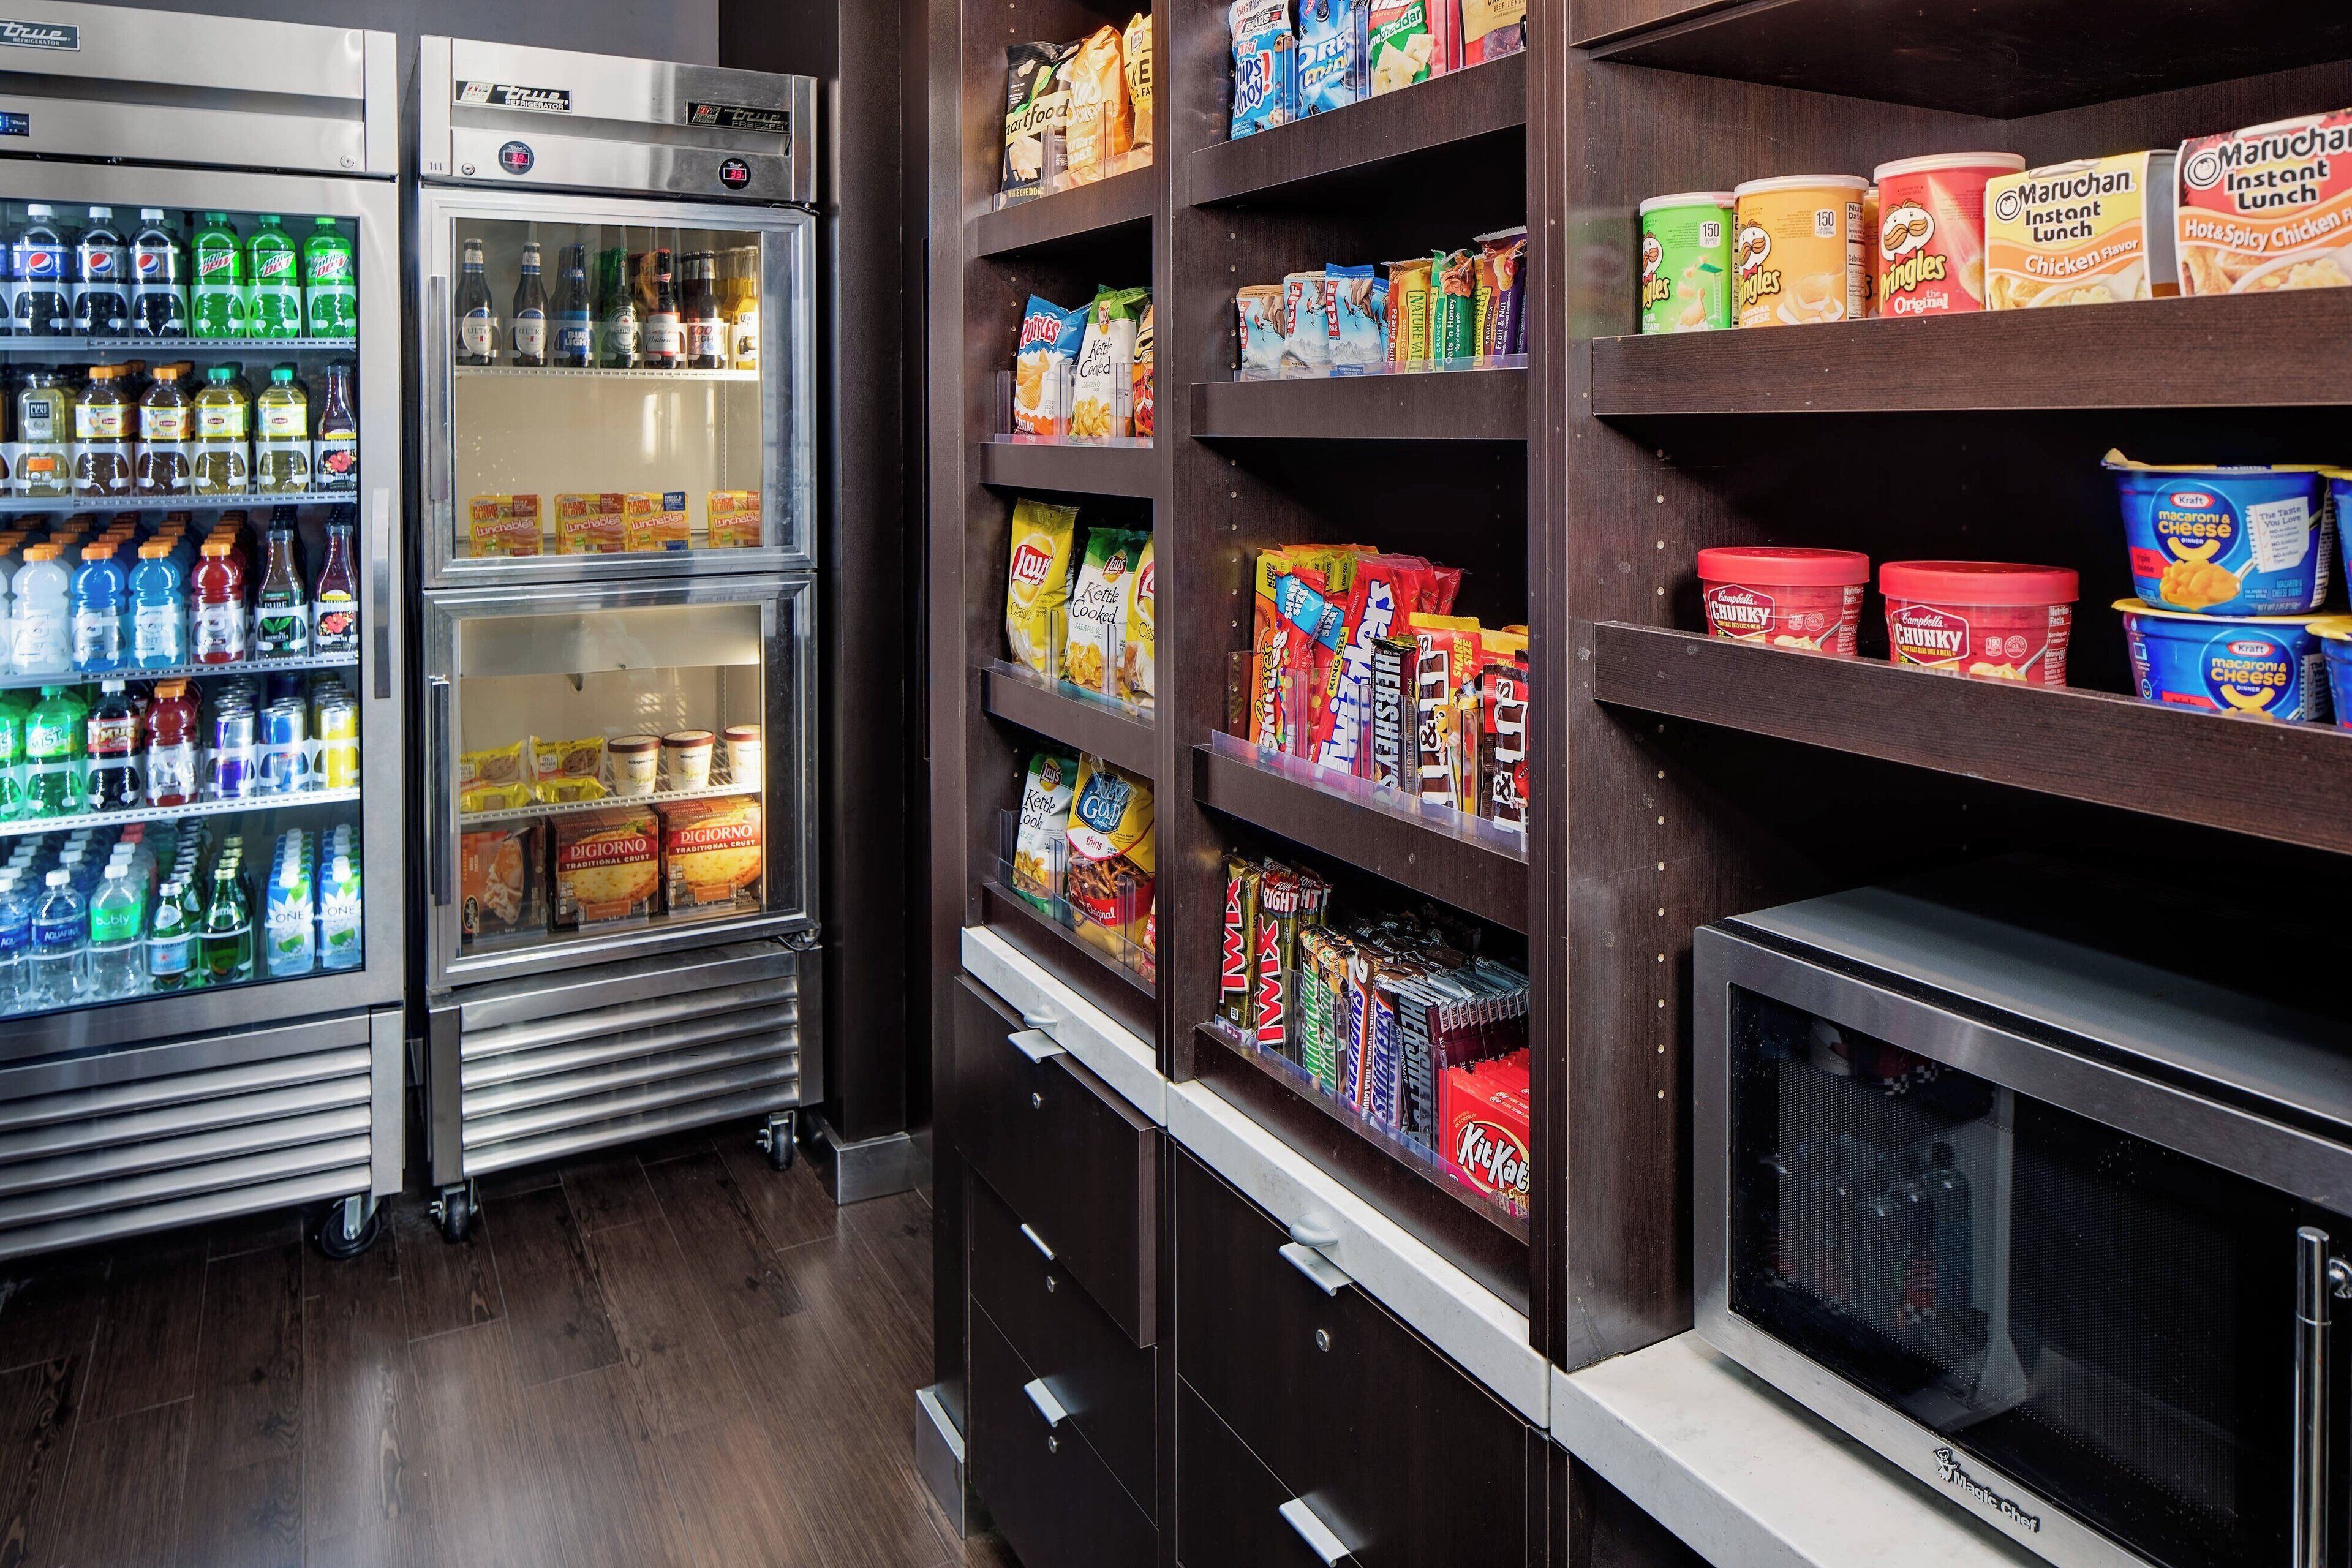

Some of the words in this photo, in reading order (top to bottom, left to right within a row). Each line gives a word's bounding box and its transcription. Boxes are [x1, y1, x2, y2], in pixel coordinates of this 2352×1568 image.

[1237, 2, 1248, 17] BIG
[13, 37, 60, 46] REFRIGERATOR
[497, 86, 565, 104] true
[505, 99, 564, 110] REFRIGERATOR
[724, 108, 784, 125] true
[732, 121, 784, 131] FREEZER
[2228, 159, 2328, 192] Instant
[1008, 189, 1019, 198] WHITE
[2020, 171, 2130, 206] Maruchan
[2238, 183, 2316, 210] Lunch
[1817, 211, 1834, 226] 150
[2026, 200, 2101, 227] Instant
[1703, 223, 1720, 238] 150
[2034, 222, 2092, 242] Lunch
[2271, 211, 2342, 247] Chicken
[2025, 251, 2101, 277] Chicken
[2101, 239, 2139, 259] Flavor
[1288, 285, 1302, 322] CLIF
[1327, 284, 1336, 323] CLIF
[1894, 293, 1949, 314] Original
[1926, 289, 1941, 298] the
[1410, 295, 1424, 339] NATURE
[1447, 298, 1457, 328] Honey
[1088, 337, 1112, 360] Kettle
[2179, 495, 2204, 505] Kraft
[631, 513, 684, 530] Lunchables
[714, 513, 760, 527] Lunchable
[2158, 510, 2219, 523] macaroni
[2222, 513, 2230, 524] &
[2260, 512, 2276, 521] The
[2277, 506, 2302, 516] Taste
[476, 519, 535, 537] Lunchables
[565, 516, 621, 533] Lunchables
[1013, 546, 1052, 586] Lay's
[1107, 557, 1126, 575] Lay's
[1080, 582, 1119, 604] Kettle
[2272, 588, 2288, 598] CHEESE
[2288, 587, 2302, 597] DINNER
[2277, 578, 2299, 588] MACARONI
[1284, 576, 1301, 620] SHARE
[1292, 589, 1310, 617] SIZE
[1349, 590, 1360, 620] STRAWBERRY
[1717, 590, 1754, 605] Campbell's
[1072, 599, 1117, 624] Cooked
[1711, 600, 1771, 626] CHUNKY
[1902, 611, 1943, 628] Campbell's
[2050, 606, 2069, 616] Nutrition
[2050, 616, 2064, 625] Facts
[1321, 611, 1338, 638] SIZE
[1895, 623, 1963, 652] CHUNKY
[1452, 637, 1463, 677] SHARE
[1462, 638, 1472, 667] SIZE
[2237, 644, 2264, 654] Kraft
[1329, 659, 1341, 690] KING
[1335, 631, 1346, 657] SIZE
[2211, 658, 2276, 671] macaroni
[2278, 661, 2287, 672] &
[1375, 653, 1401, 788] HERSHEY'S
[1042, 766, 1060, 783] Lay's
[1024, 788, 1055, 813] Kettle
[1082, 796, 1121, 827] GOLD
[680, 825, 752, 845] DIGIORNO
[1086, 835, 1102, 851] thins
[571, 839, 646, 859] DIGIORNO
[676, 843, 728, 854] TRADITIONAL
[566, 858, 621, 870] TRADITIONAL
[624, 854, 650, 862] CRUST
[1275, 881, 1292, 890] FOUR
[1264, 889, 1299, 913] RIGHT
[276, 911, 304, 922] ONE
[327, 907, 355, 917] ONE
[1087, 903, 1116, 921] Original
[1220, 876, 1249, 1003] TWIX
[1257, 919, 1284, 1052] TWIX
[1373, 1005, 1395, 1118] SNICKERS
[1954, 1471, 1998, 1508] Magic
[2000, 1499, 2039, 1534] Chef
